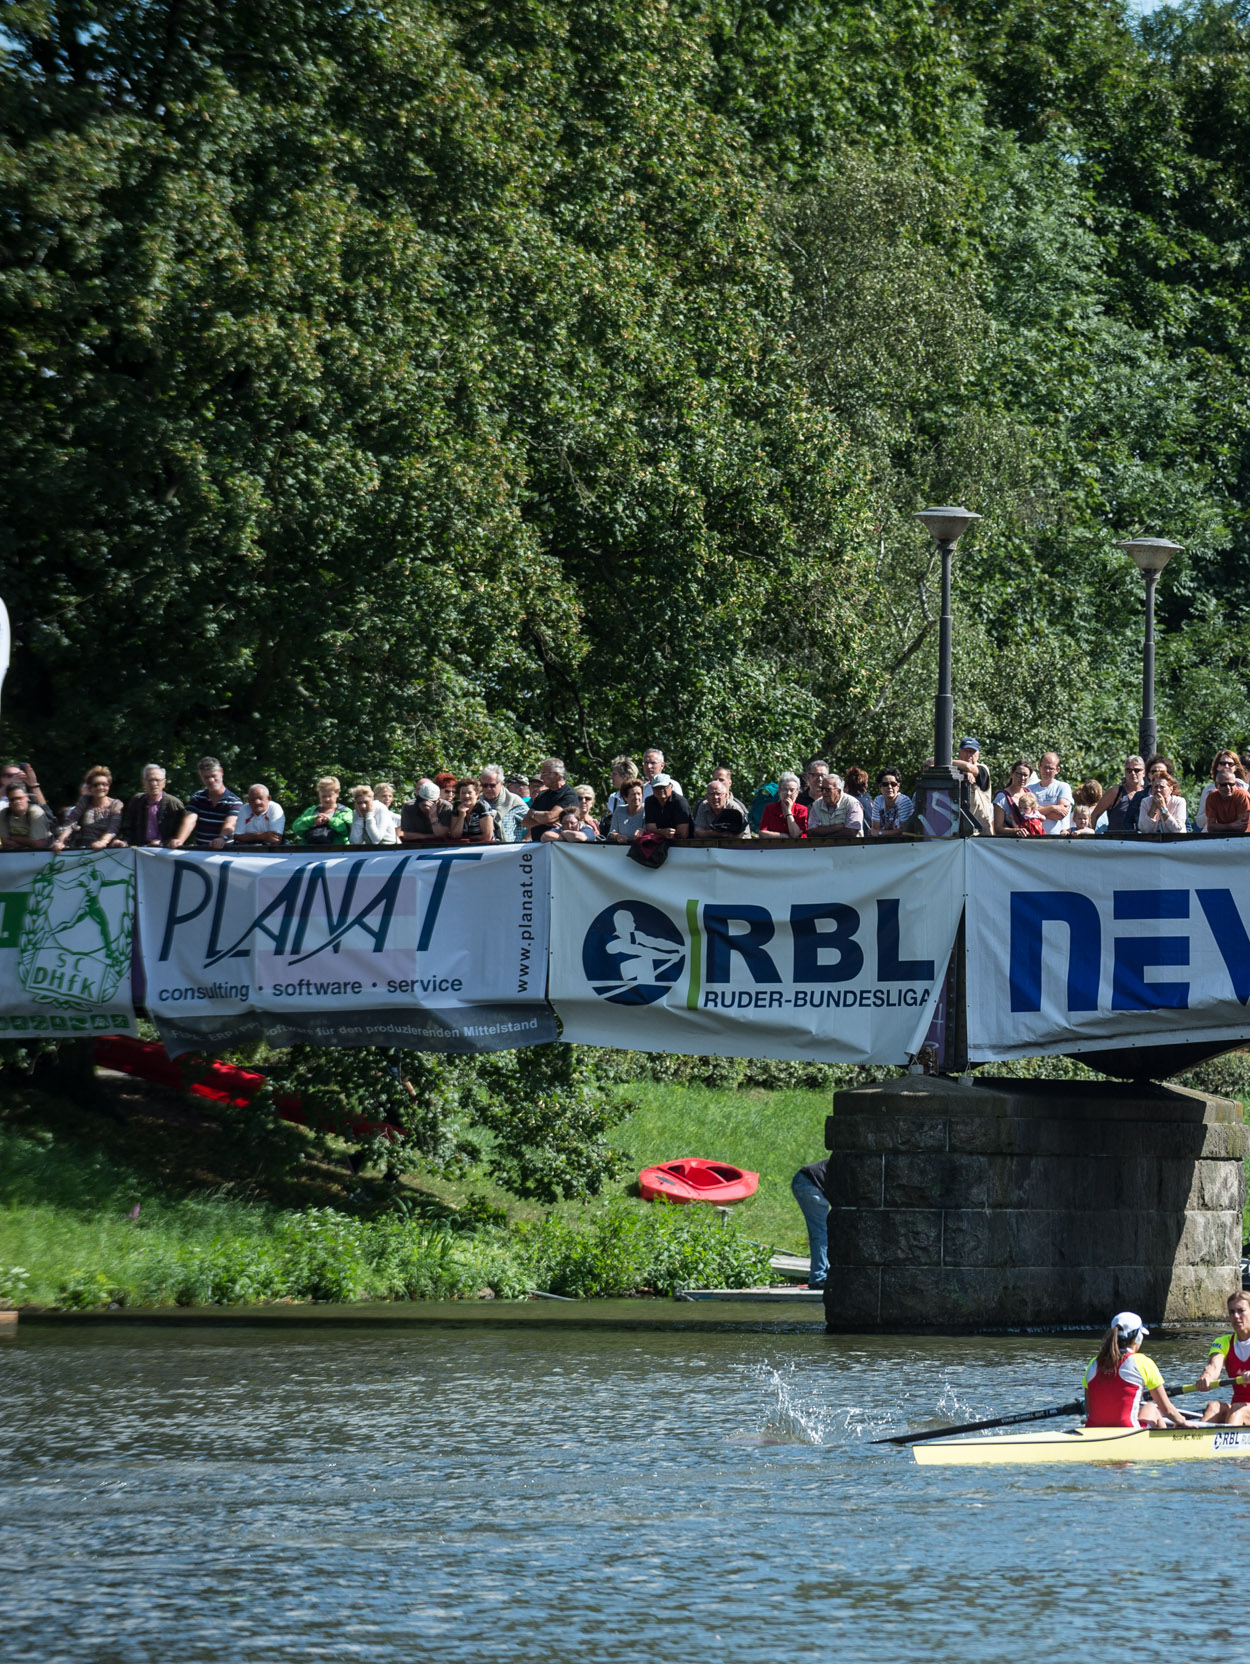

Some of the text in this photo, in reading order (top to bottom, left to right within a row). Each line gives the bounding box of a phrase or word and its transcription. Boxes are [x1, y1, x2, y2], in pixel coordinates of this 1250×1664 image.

[159, 852, 484, 968] PLANAT
[517, 852, 534, 994] www.planat.de
[703, 898, 935, 984] RBL
[158, 974, 464, 1002] consulting software service
[464, 1017, 539, 1037] Mittelstand
[1222, 1432, 1240, 1445] RBL
